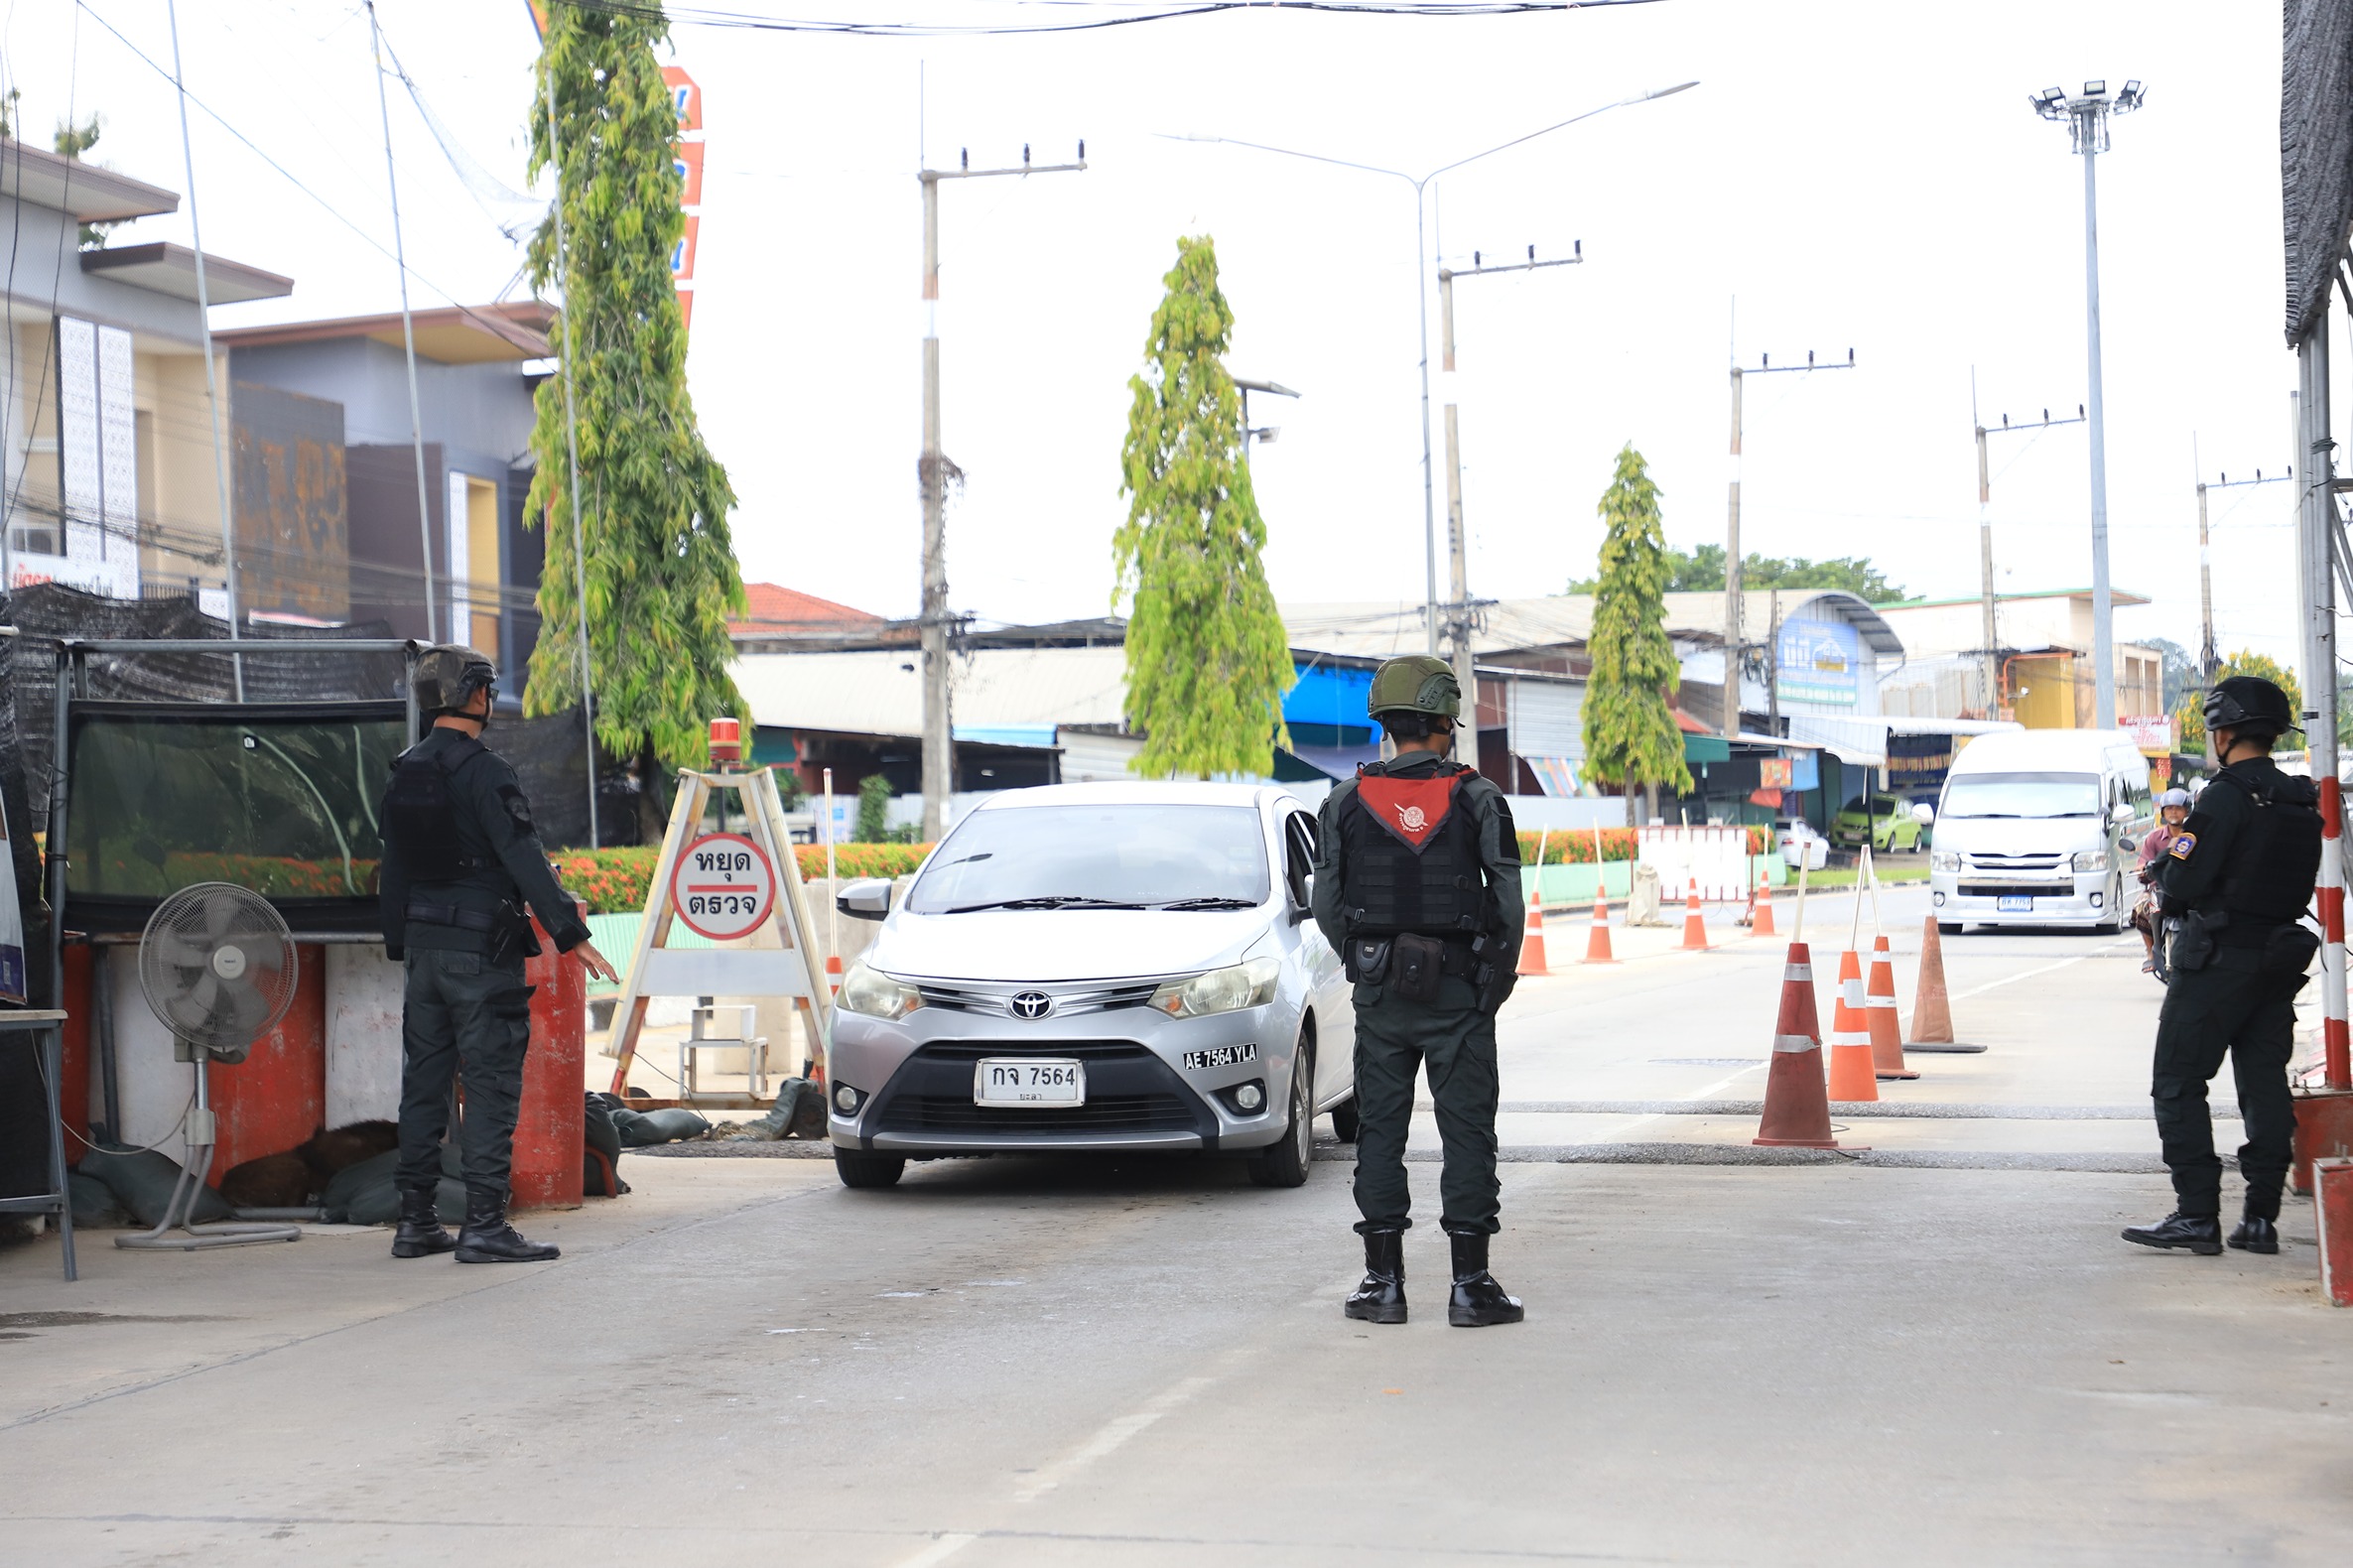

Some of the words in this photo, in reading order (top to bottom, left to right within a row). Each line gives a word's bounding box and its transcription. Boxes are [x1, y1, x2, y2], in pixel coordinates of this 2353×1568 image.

[695, 852, 750, 882] หยุด
[689, 895, 756, 915] ตรวจ
[1185, 1052, 1202, 1070] AE
[1204, 1047, 1233, 1067] 7564
[1235, 1044, 1256, 1063] YLA
[992, 1067, 1019, 1086] กจ
[1030, 1067, 1075, 1086] 7564
